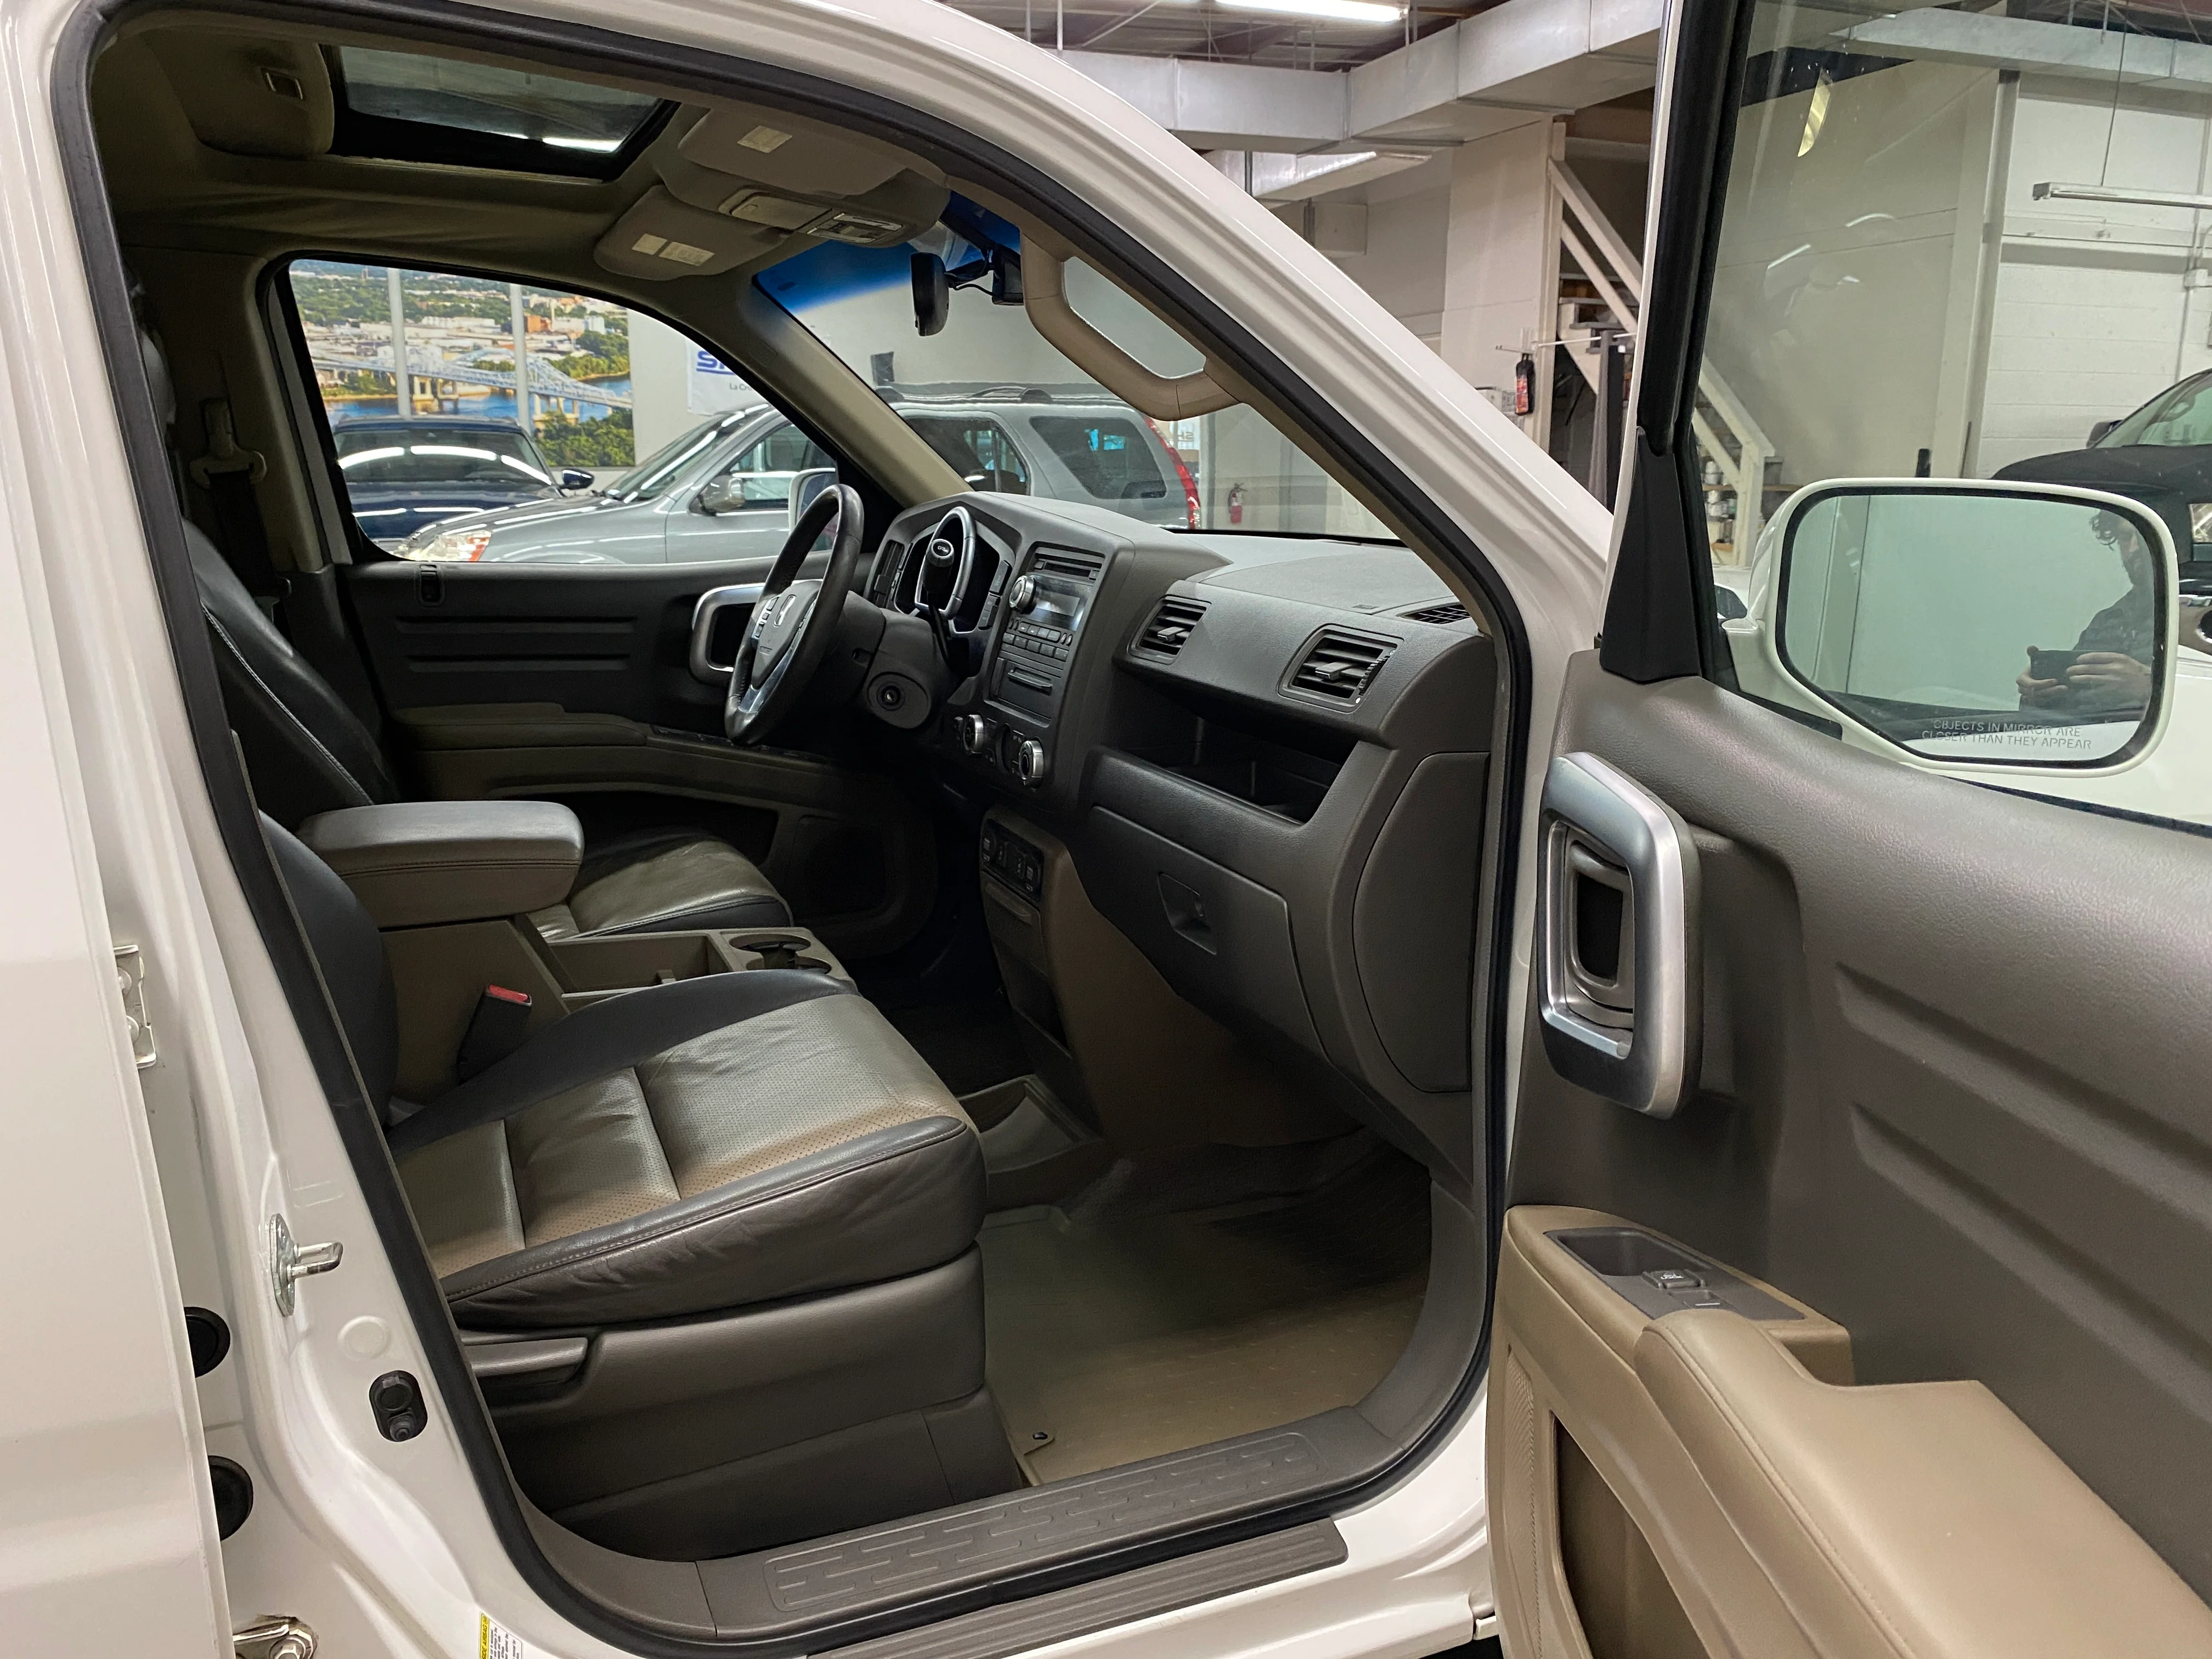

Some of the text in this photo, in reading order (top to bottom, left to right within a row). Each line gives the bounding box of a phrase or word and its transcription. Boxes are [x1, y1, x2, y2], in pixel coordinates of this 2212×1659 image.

[697, 351, 725, 369] S
[1933, 719, 2081, 737] OBJECTS IN MIRROR ARE
[1921, 730, 2092, 749] CLOSER THAN THEY APPEAR
